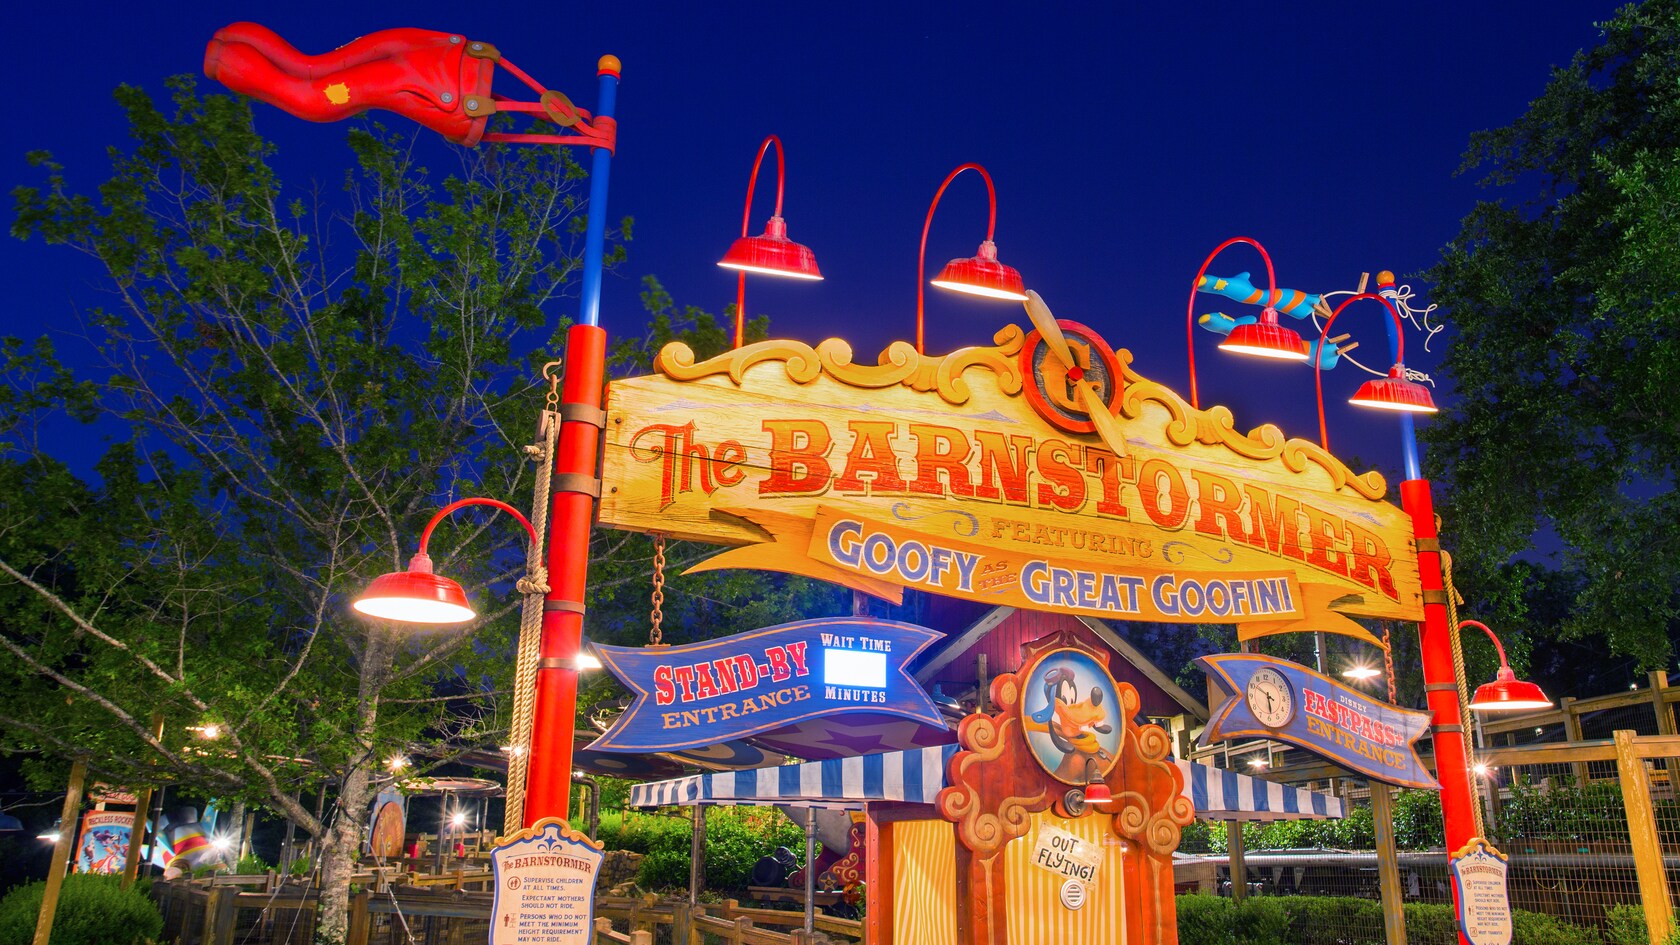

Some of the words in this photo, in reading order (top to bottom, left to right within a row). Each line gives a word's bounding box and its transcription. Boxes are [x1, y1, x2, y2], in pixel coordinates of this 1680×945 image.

[629, 419, 748, 513] The
[759, 419, 1401, 606] BARNSTORMER
[990, 517, 1154, 558] FEATURING
[828, 519, 985, 594] GOOFY
[980, 560, 1009, 576] AS
[978, 572, 1018, 590] THE
[1020, 559, 1145, 614] GREAT
[1150, 573, 1296, 617] GOOFINI
[820, 633, 854, 649] WAIT
[860, 636, 892, 652] TIME
[654, 641, 810, 706] STAND-BY
[662, 685, 811, 729] ENTRANCE
[825, 686, 886, 703] MINUTES
[1340, 695, 1367, 712] DISNEY
[1303, 688, 1404, 749] FASTPASS+
[1306, 714, 1407, 770] ENTRANCE
[1051, 836, 1079, 853] OUT
[502, 860, 514, 874] The
[514, 856, 592, 874] BARNSTORMER
[1038, 848, 1095, 881] FLYING!
